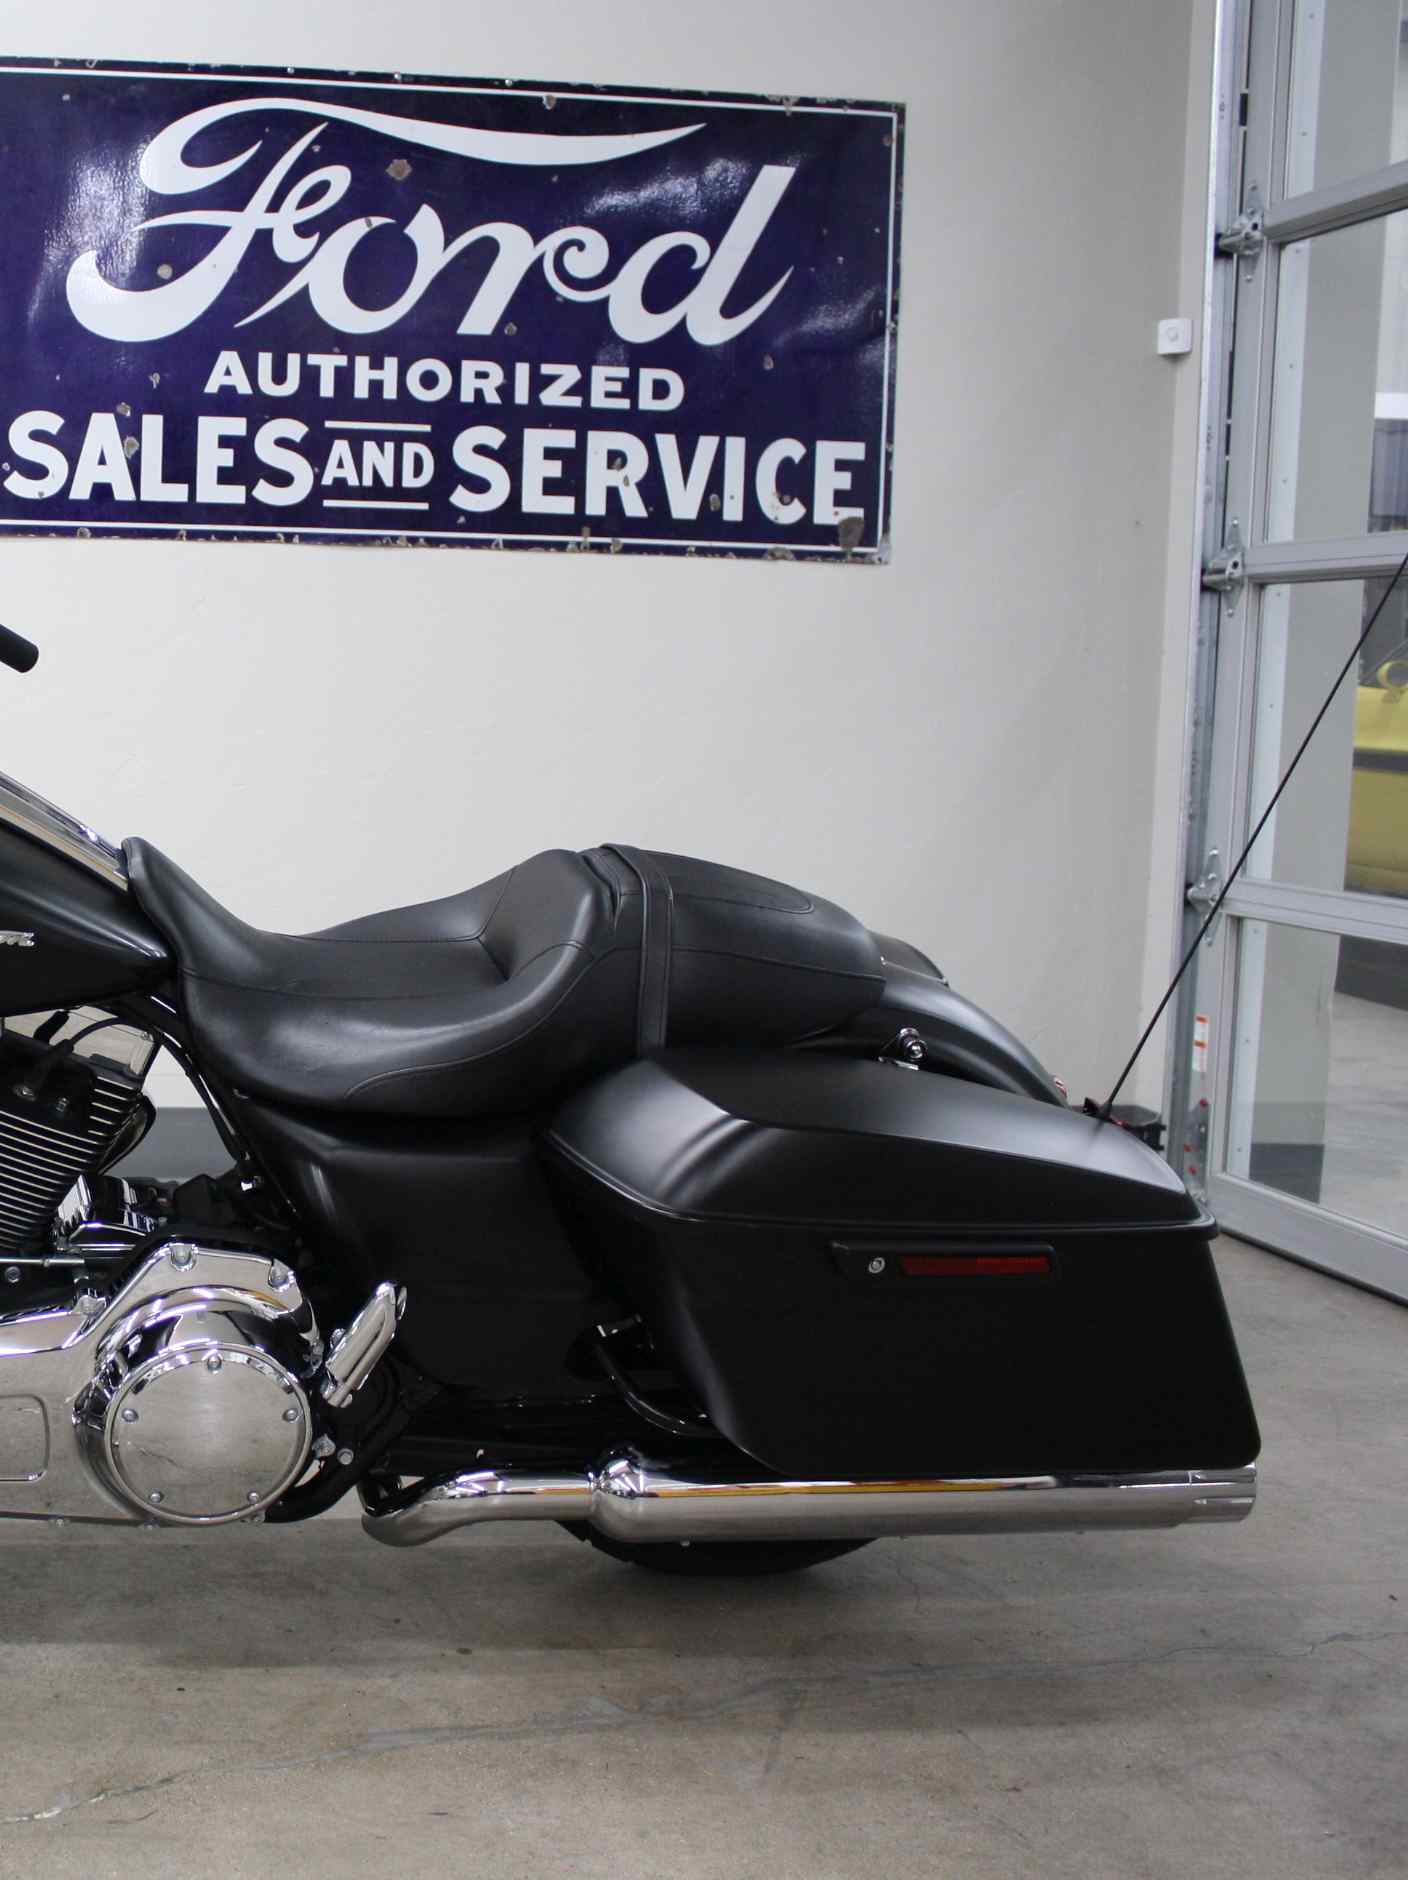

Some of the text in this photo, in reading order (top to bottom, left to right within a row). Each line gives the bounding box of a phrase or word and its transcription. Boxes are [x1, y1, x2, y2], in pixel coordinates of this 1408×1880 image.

[66, 97, 796, 345] Ford
[204, 350, 684, 411] AUTHORIZED
[3, 410, 865, 526] SALES AND SERVICE
